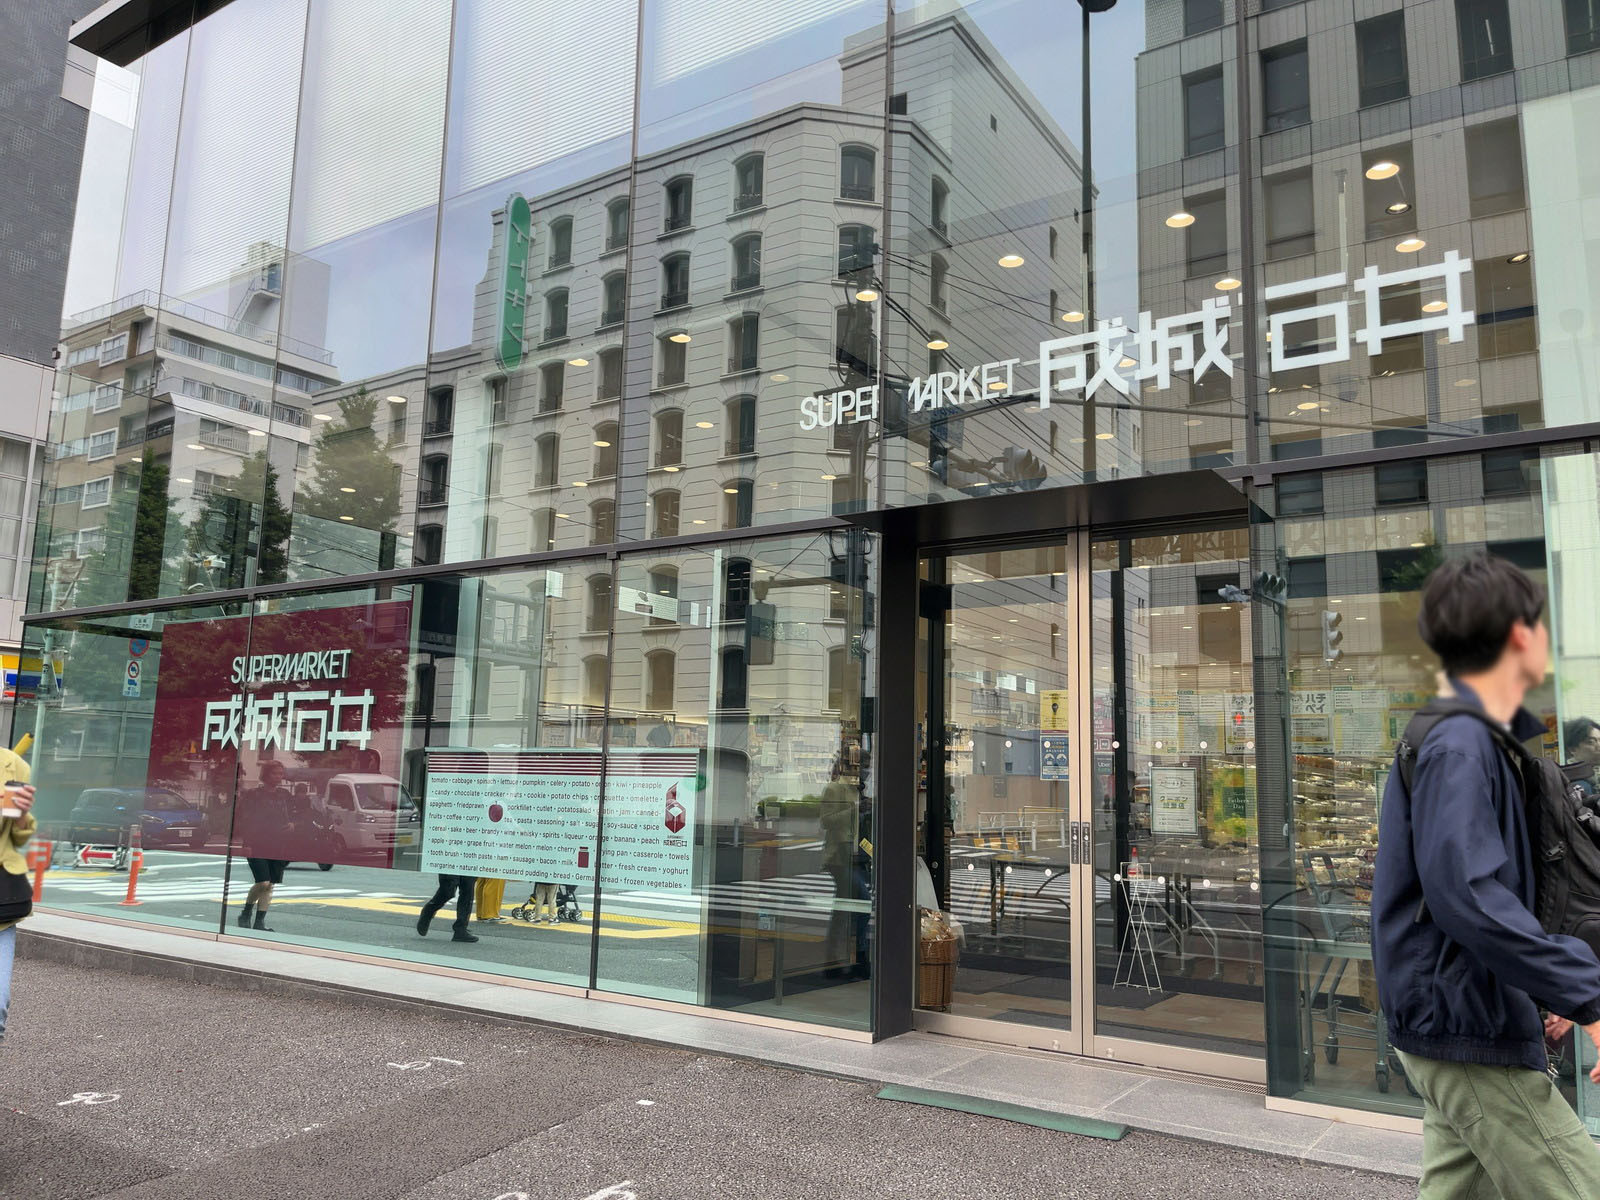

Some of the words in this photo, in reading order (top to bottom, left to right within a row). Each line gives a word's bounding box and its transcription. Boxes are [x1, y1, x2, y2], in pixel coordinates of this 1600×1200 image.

[1039, 250, 1475, 410] 成城石井
[231, 649, 352, 684] SUPERMARKET
[202, 689, 375, 751] 成城石井
[550, 779, 567, 787] celery
[619, 808, 630, 816] jam
[520, 830, 538, 838] whisky
[543, 831, 560, 839] spirits
[614, 835, 636, 843] banana
[641, 837, 659, 845] peach
[536, 843, 552, 851] melon
[558, 845, 576, 854] cherry
[669, 852, 689, 860] towels
[464, 851, 477, 859] tooth
[513, 856, 535, 864] sausage
[540, 857, 557, 865] bacon
[619, 862, 635, 871] fresh
[662, 867, 688, 876] yoghurt
[525, 869, 548, 878] pudding
[576, 873, 596, 882] Germa
[601, 875, 618, 883] bread
[624, 877, 644, 885] frozen
[647, 879, 682, 889] vegetables
